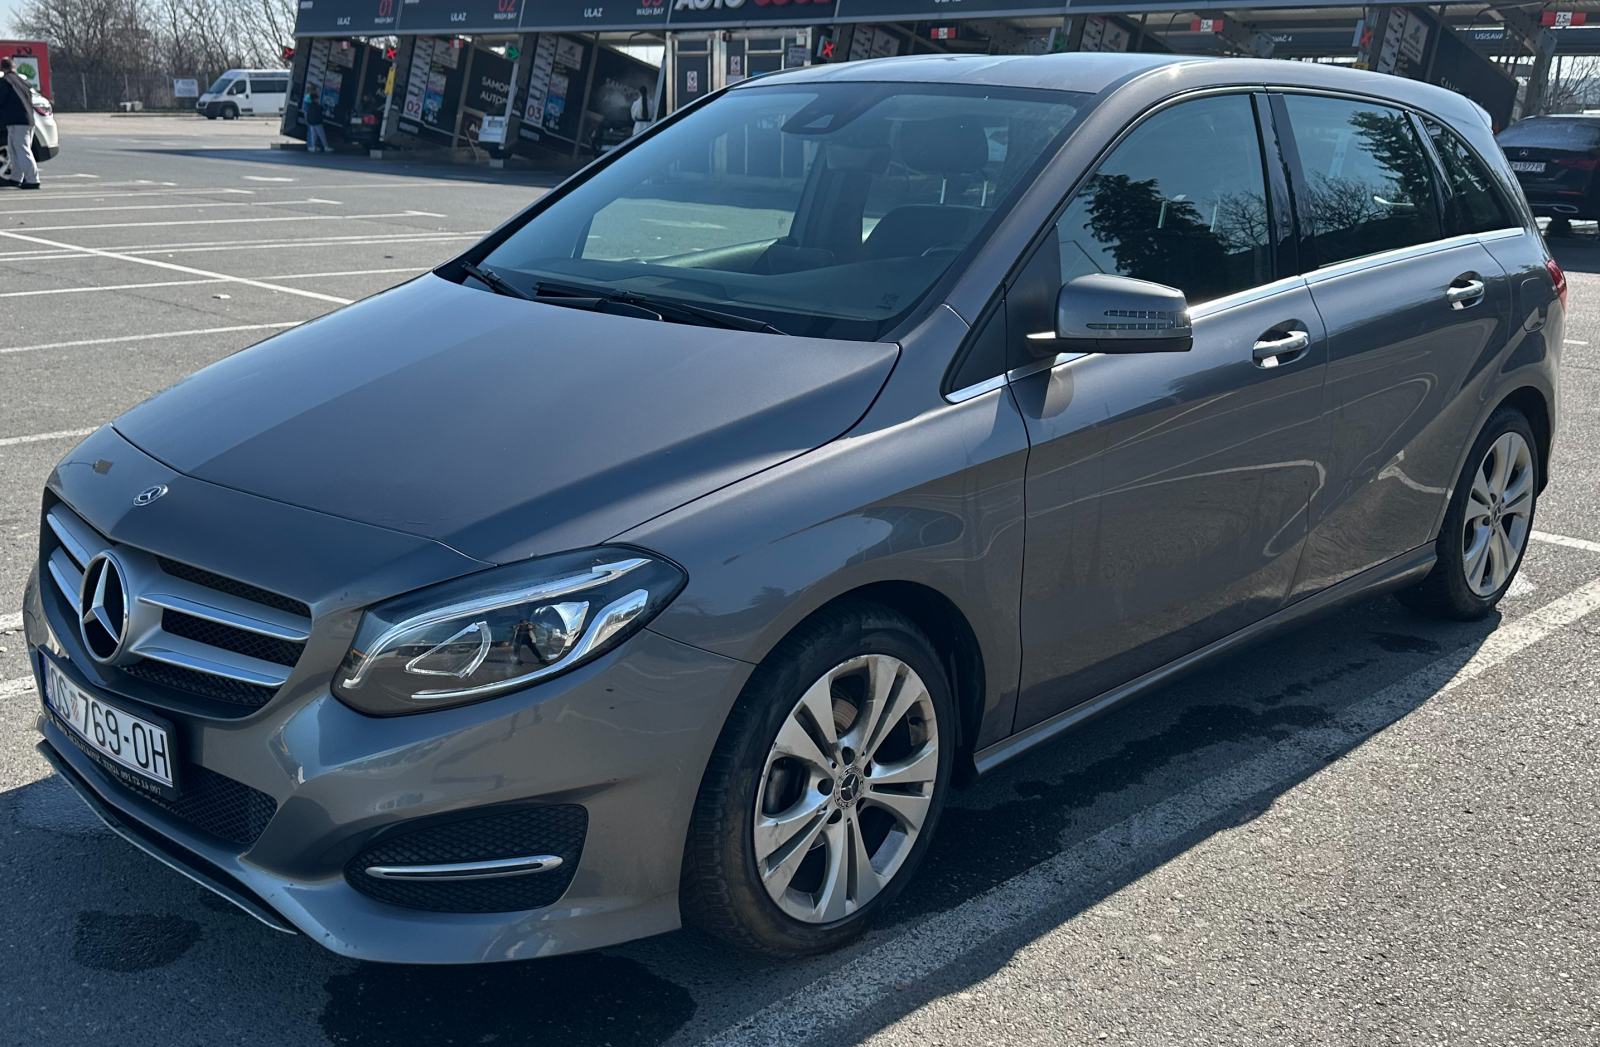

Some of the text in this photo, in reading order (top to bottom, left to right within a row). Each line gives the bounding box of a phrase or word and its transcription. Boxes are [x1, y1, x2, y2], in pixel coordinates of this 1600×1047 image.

[584, 8, 603, 18] ULAZ
[636, 8, 652, 16] WASH
[406, 101, 421, 113] 02
[527, 104, 542, 120] 03
[78, 692, 169, 779] 769-OH
